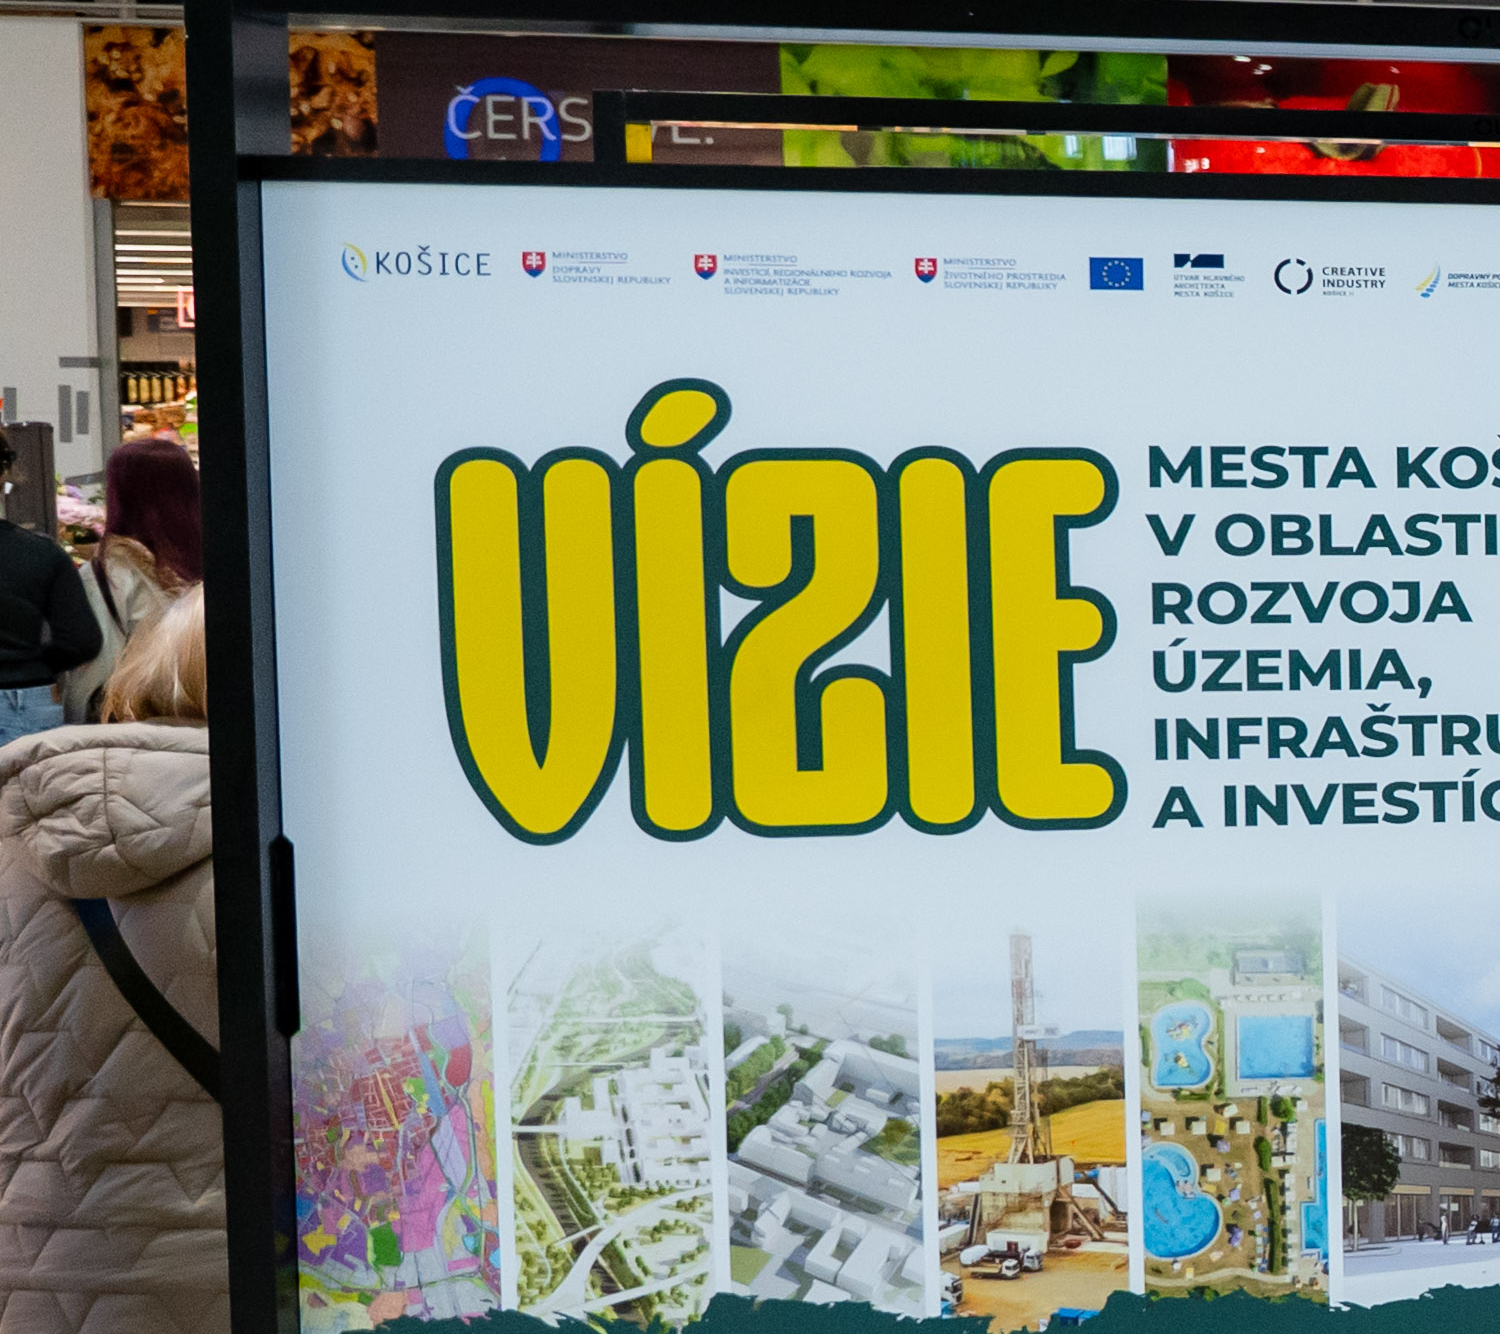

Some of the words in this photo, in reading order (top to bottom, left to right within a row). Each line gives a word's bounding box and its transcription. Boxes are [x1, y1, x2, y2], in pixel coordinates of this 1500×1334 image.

[375, 244, 492, 276] KOŠICE
[552, 251, 629, 261] MINISTERSTVO
[552, 267, 602, 275] DOPRAVY
[723, 254, 798, 264] MINISTERSTVO
[943, 257, 1017, 267] MINISTERSTVO
[1322, 266, 1386, 277] CREATIVE
[1321, 278, 1387, 289] INDUSTRY
[1148, 445, 1377, 489] MESTA
[1146, 514, 1196, 556] V
[1215, 513, 1498, 556] OBLASTI
[434, 376, 1129, 847] VÍZIE
[1151, 580, 1473, 625] ROZVOJA
[1152, 638, 1433, 699] ÚZEMIA,
[1152, 785, 1204, 829] A
